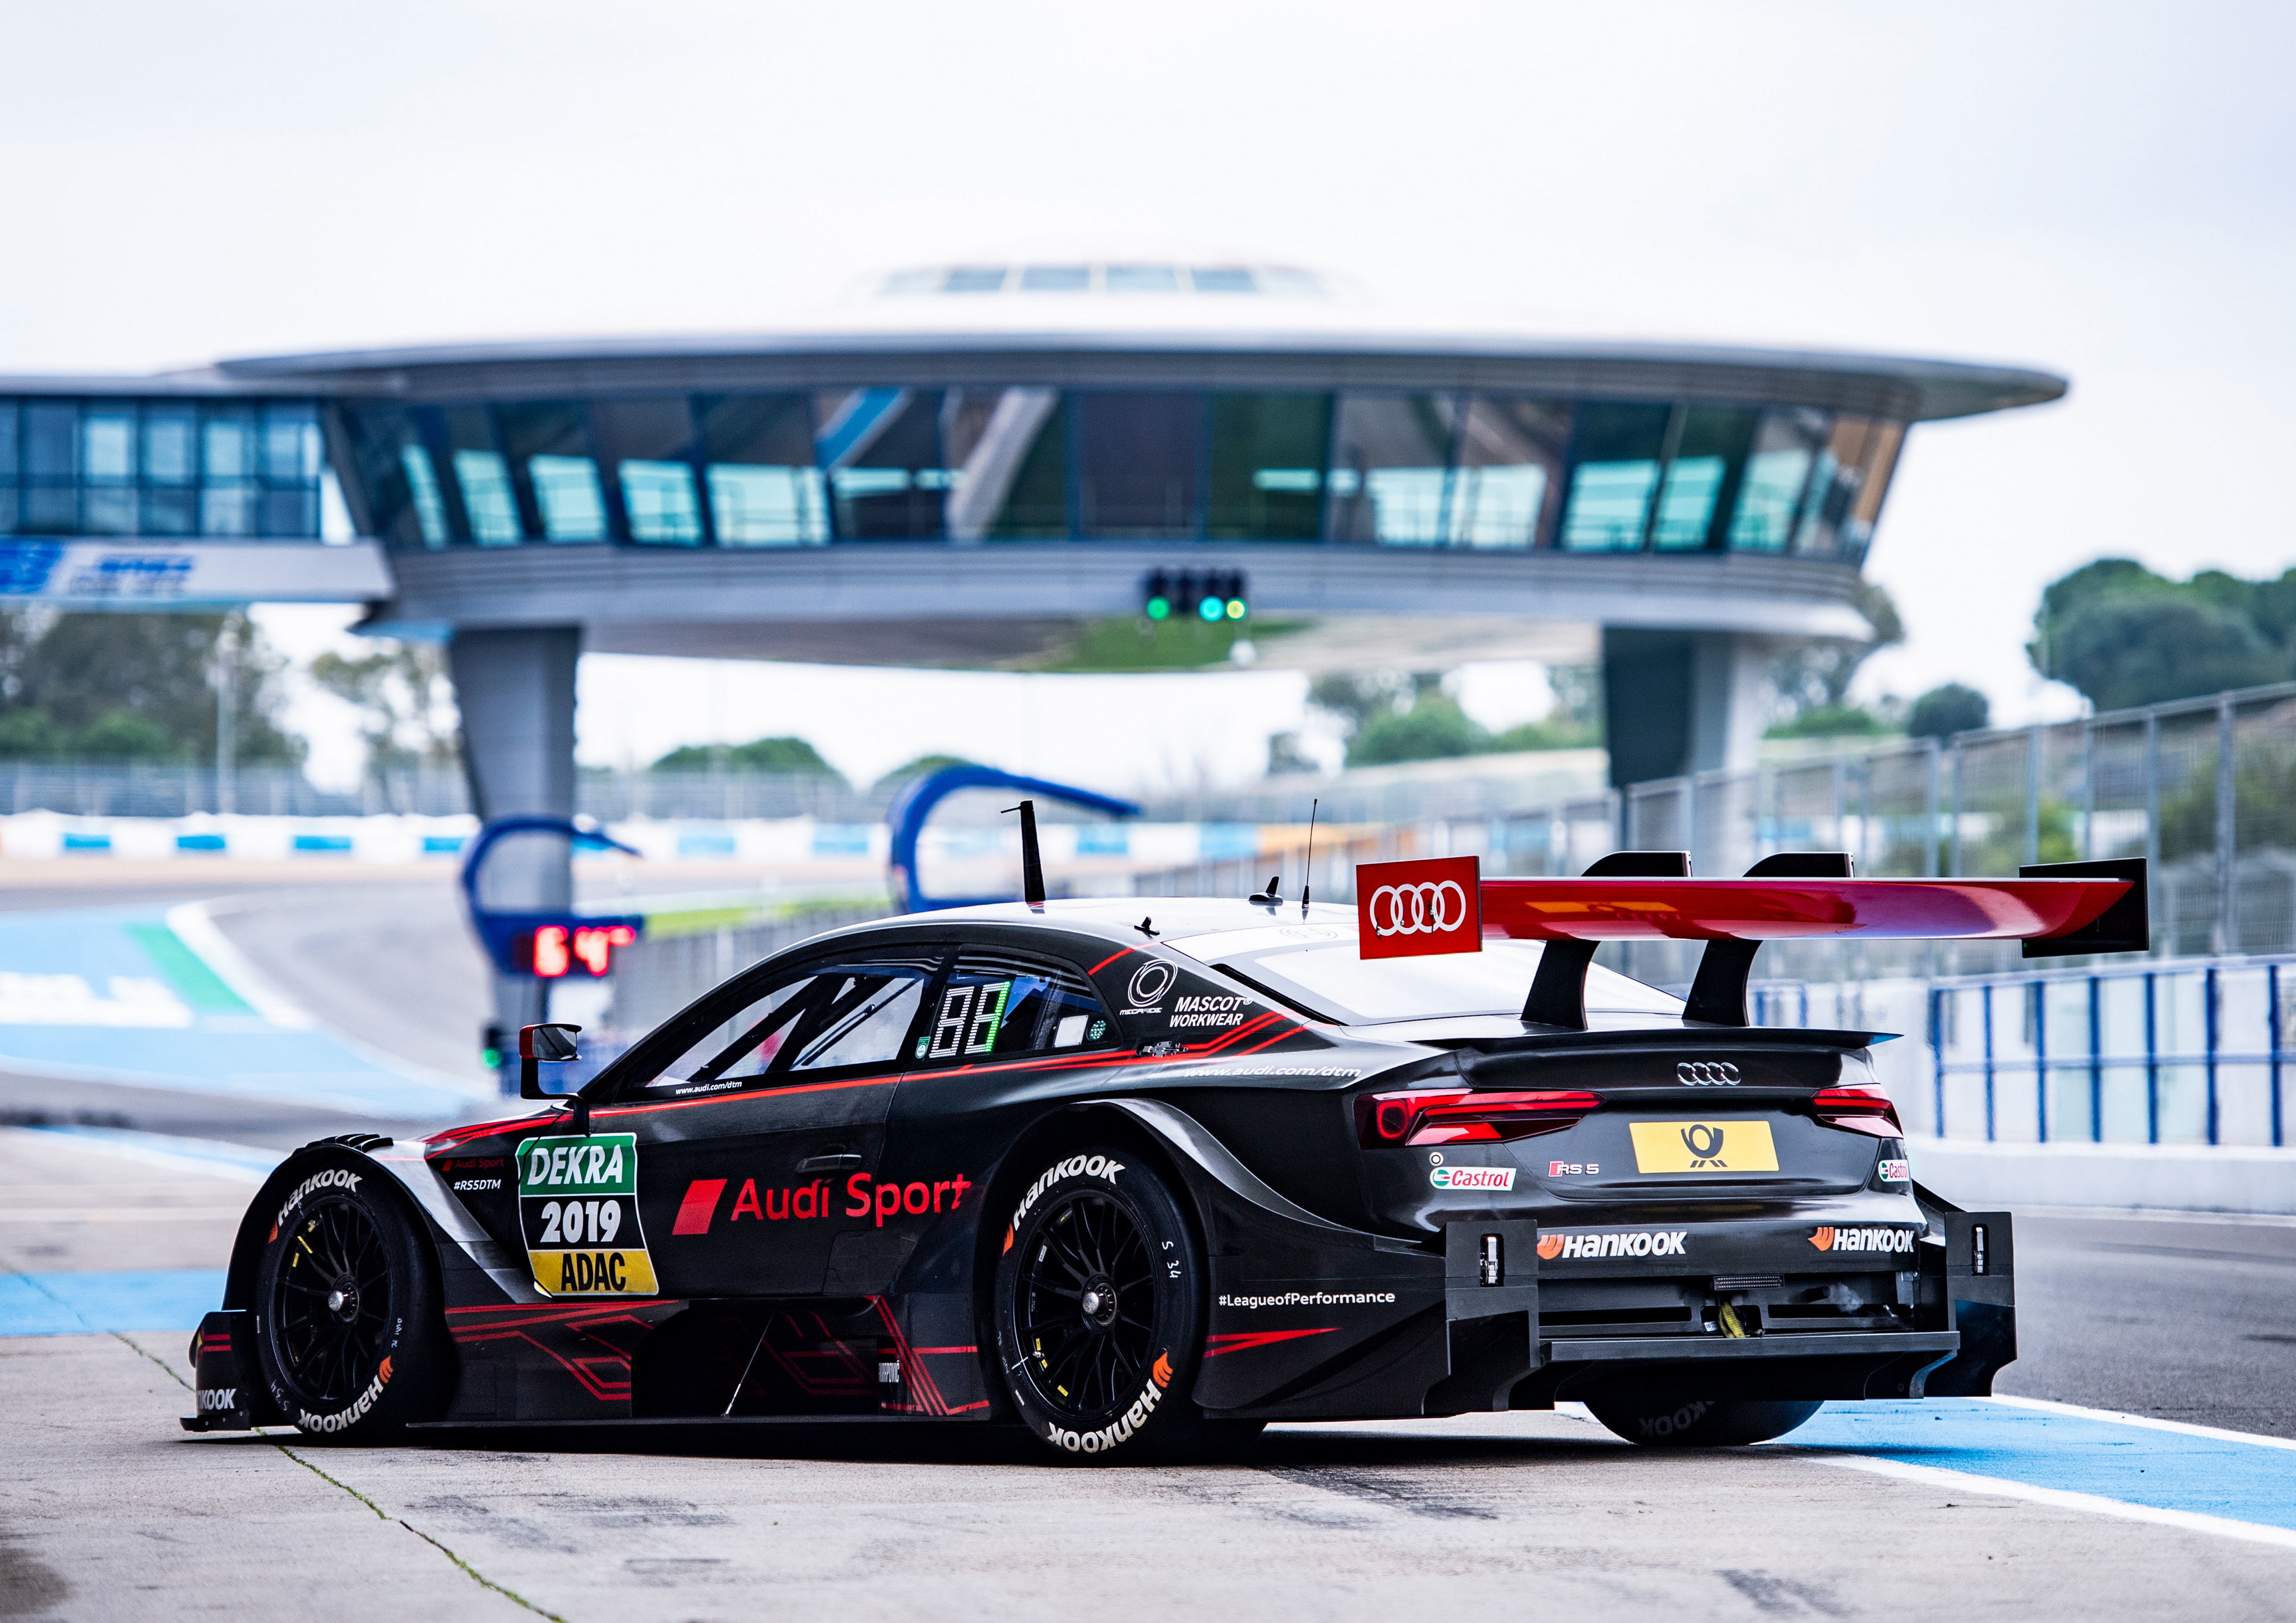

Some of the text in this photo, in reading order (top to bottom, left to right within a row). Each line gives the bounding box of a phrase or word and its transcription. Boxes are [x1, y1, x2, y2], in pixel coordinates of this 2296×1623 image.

[1169, 1013, 1243, 1027] WORKWEAR
[1184, 1066, 1361, 1077] www.audi.com/dtm
[675, 1081, 742, 1095] www.audi.com/dtm
[455, 1158, 504, 1170] Audi Sport
[527, 1144, 623, 1185] DEKRA
[1557, 1163, 1599, 1175] RS 5
[453, 1179, 501, 1190] #RS5DTM
[1452, 1170, 1509, 1187] Castrol
[730, 1172, 971, 1227] Audi Sport
[540, 1200, 621, 1243] 2019
[561, 1252, 626, 1291] ADAC
[1219, 1287, 1395, 1309] #LeagueofPerformance
[197, 1388, 236, 1410] nKOOK
